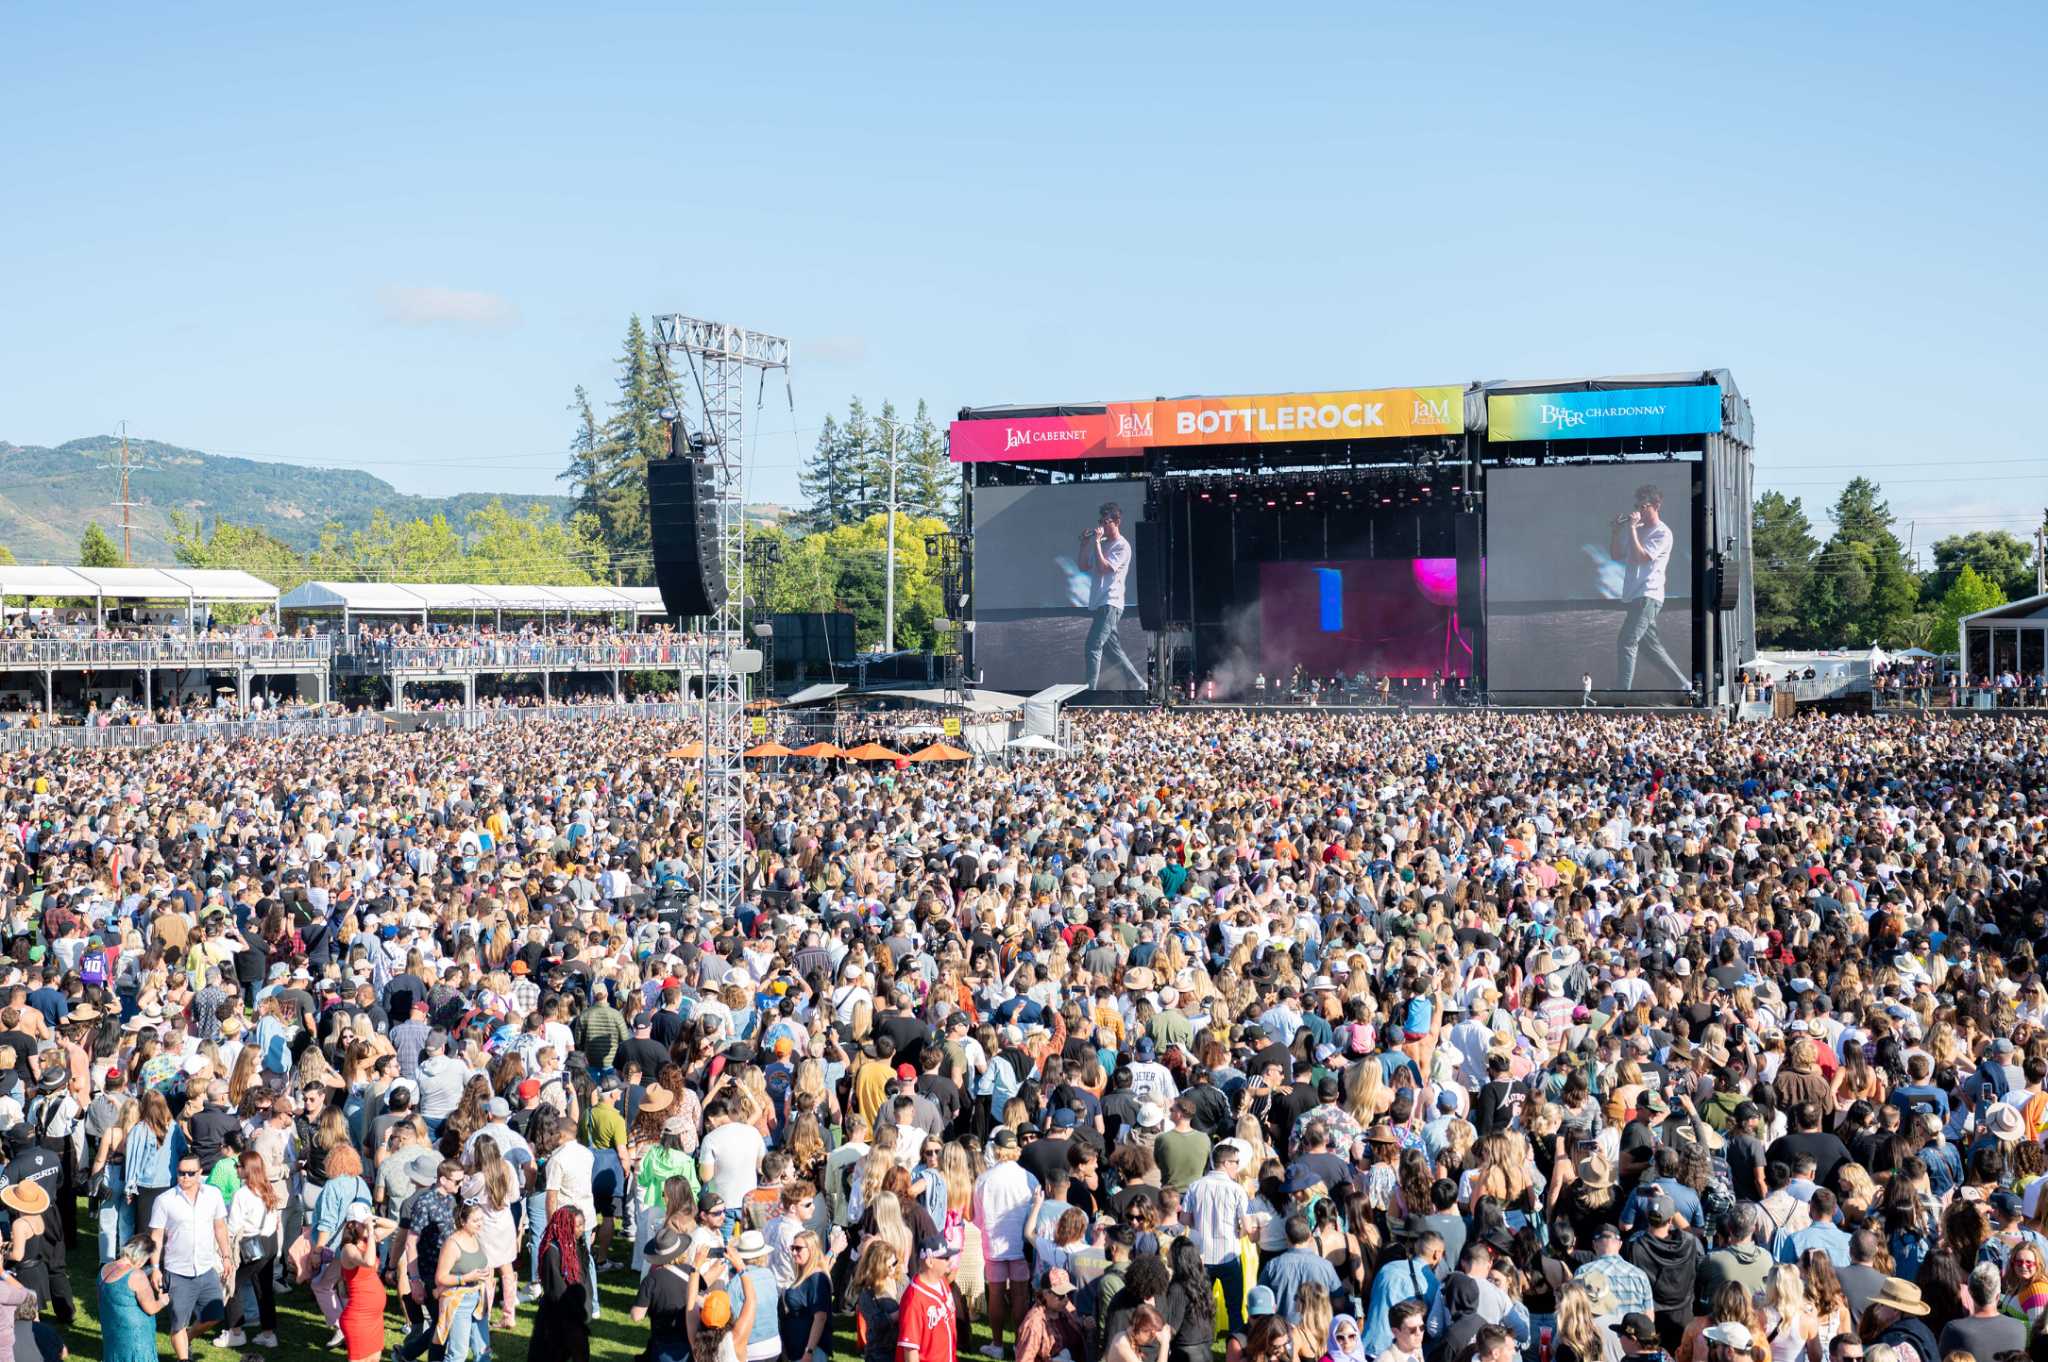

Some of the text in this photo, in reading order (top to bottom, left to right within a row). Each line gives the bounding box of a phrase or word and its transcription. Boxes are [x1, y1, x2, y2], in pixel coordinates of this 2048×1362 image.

[1586, 405, 1666, 417] CHARDONNAY
[1177, 402, 1385, 434] BOTTLEROCK
[1033, 430, 1088, 442] CABERNET
[1135, 1071, 1156, 1081] JETER
